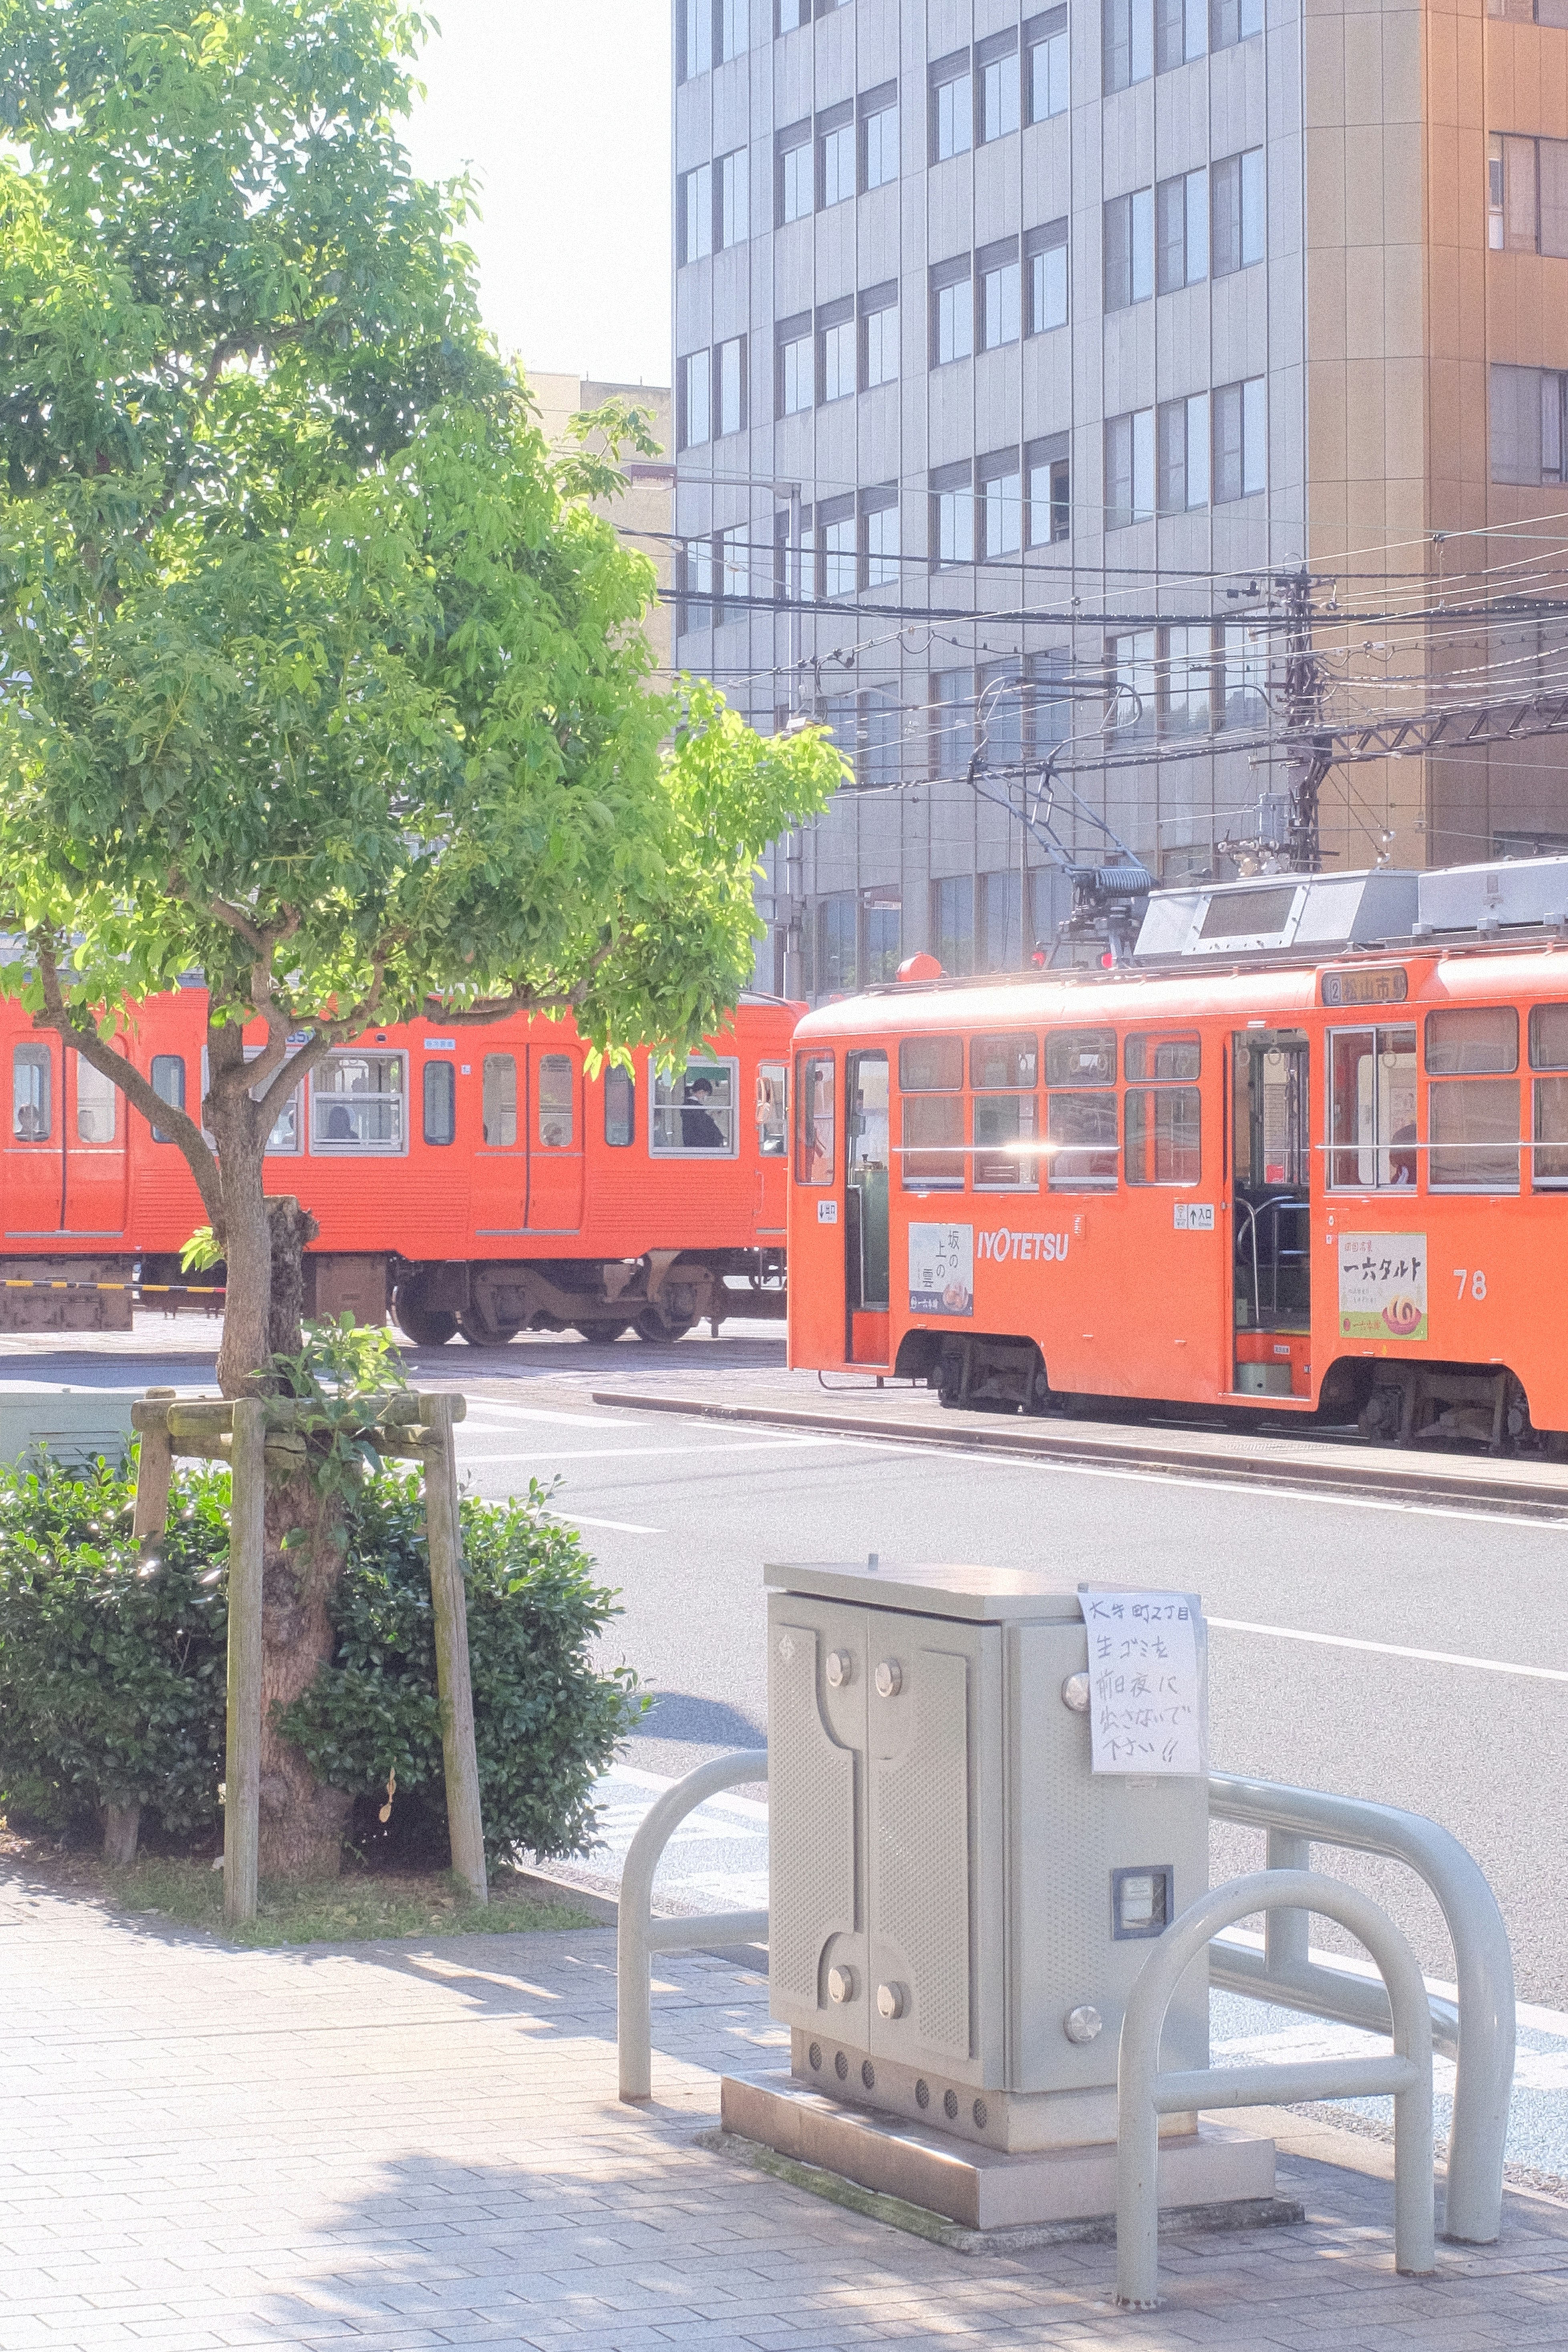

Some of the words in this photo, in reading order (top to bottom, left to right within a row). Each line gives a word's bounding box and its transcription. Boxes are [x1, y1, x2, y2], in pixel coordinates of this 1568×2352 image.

[1332, 982, 1339, 999] 2
[1199, 1208, 1211, 1219] 入口
[948, 1229, 960, 1268] 坂の
[977, 1227, 1069, 1262] IYOTETSU
[936, 1240, 946, 1278] 上の
[1344, 1257, 1421, 1282] 一六タルト
[922, 1268, 934, 1288] 雲
[1453, 1269, 1487, 1301] 78
[1097, 1635, 1169, 1659] 生ゴミを
[1096, 1669, 1178, 1700] 前日夜に
[1100, 1706, 1191, 1734] 出さないで
